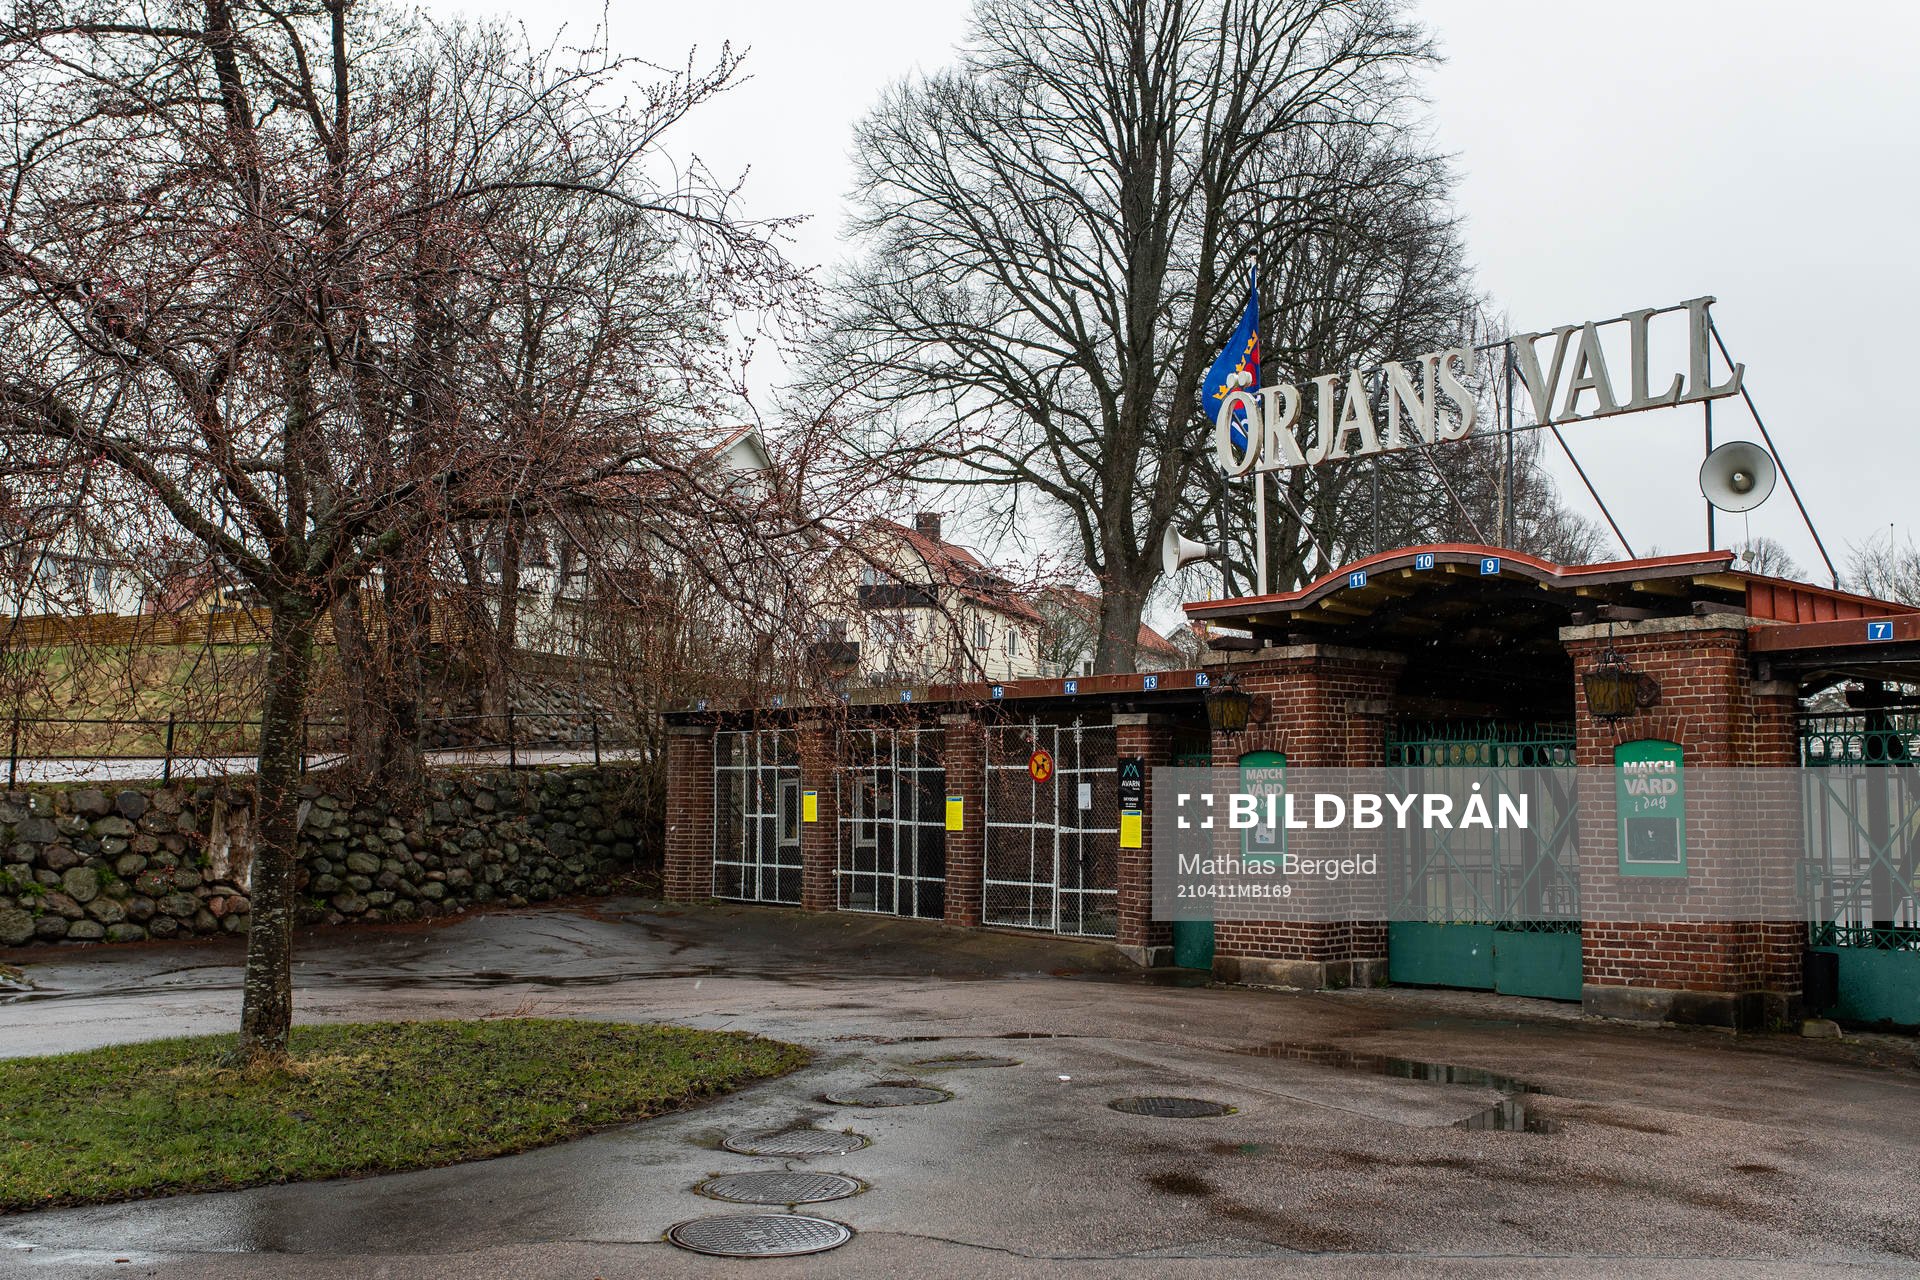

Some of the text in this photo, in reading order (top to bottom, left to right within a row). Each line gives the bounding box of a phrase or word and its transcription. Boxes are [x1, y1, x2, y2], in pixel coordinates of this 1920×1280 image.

[1215, 296, 1745, 475] ÖRJANS VALL
[1418, 556, 1432, 568] 10
[1352, 574, 1364, 586] 11
[1875, 624, 1885, 638] 7
[1145, 678, 1156, 688] 13
[1197, 674, 1208, 686] 12
[1066, 682, 1076, 693] 14
[1624, 760, 1676, 774] MATCH
[1246, 768, 1283, 780] MATCH
[1246, 780, 1284, 798] VÄRD
[1624, 774, 1678, 795] VÄRD
[1643, 796, 1668, 810] dag
